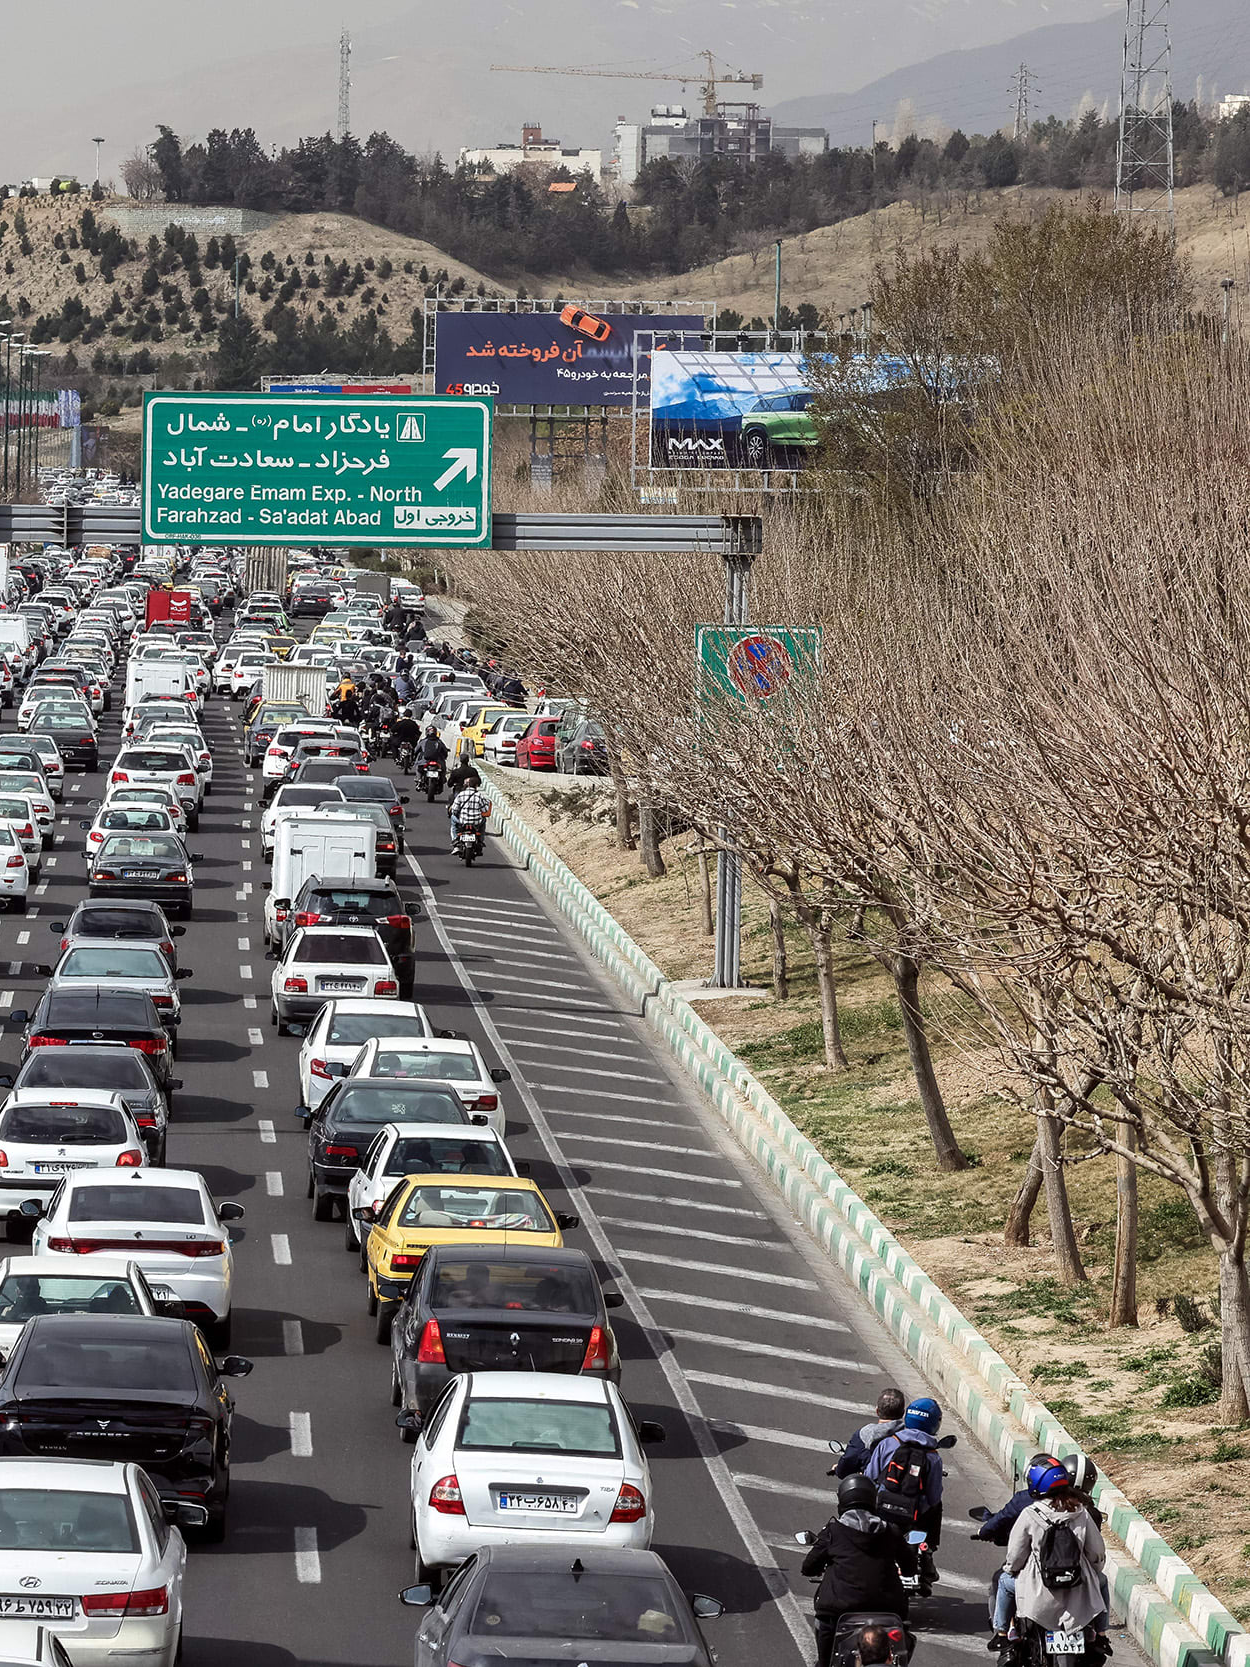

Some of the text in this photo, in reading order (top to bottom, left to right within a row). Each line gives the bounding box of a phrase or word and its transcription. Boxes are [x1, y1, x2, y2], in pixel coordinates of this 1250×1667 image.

[466, 340, 496, 357] شد
[498, 340, 560, 363] فروخته
[600, 370, 612, 381] به
[612, 370, 648, 382] مرجعه
[167, 412, 231, 436] شمال
[324, 412, 391, 441] یادگار
[668, 437, 724, 451] MAX
[162, 446, 208, 472] آباد
[209, 449, 295, 468] سعادت
[314, 448, 390, 476] فرحزاد
[157, 483, 245, 503] Yadegare
[250, 485, 306, 501] Emam
[312, 485, 352, 505] Exp.
[370, 485, 422, 503] North
[157, 507, 242, 524] Farahzad
[259, 508, 329, 525] Sa'adat
[333, 509, 381, 526] Abad
[395, 509, 475, 527] خروجی اول
[28, 1600, 53, 1614] ۷۵۹
